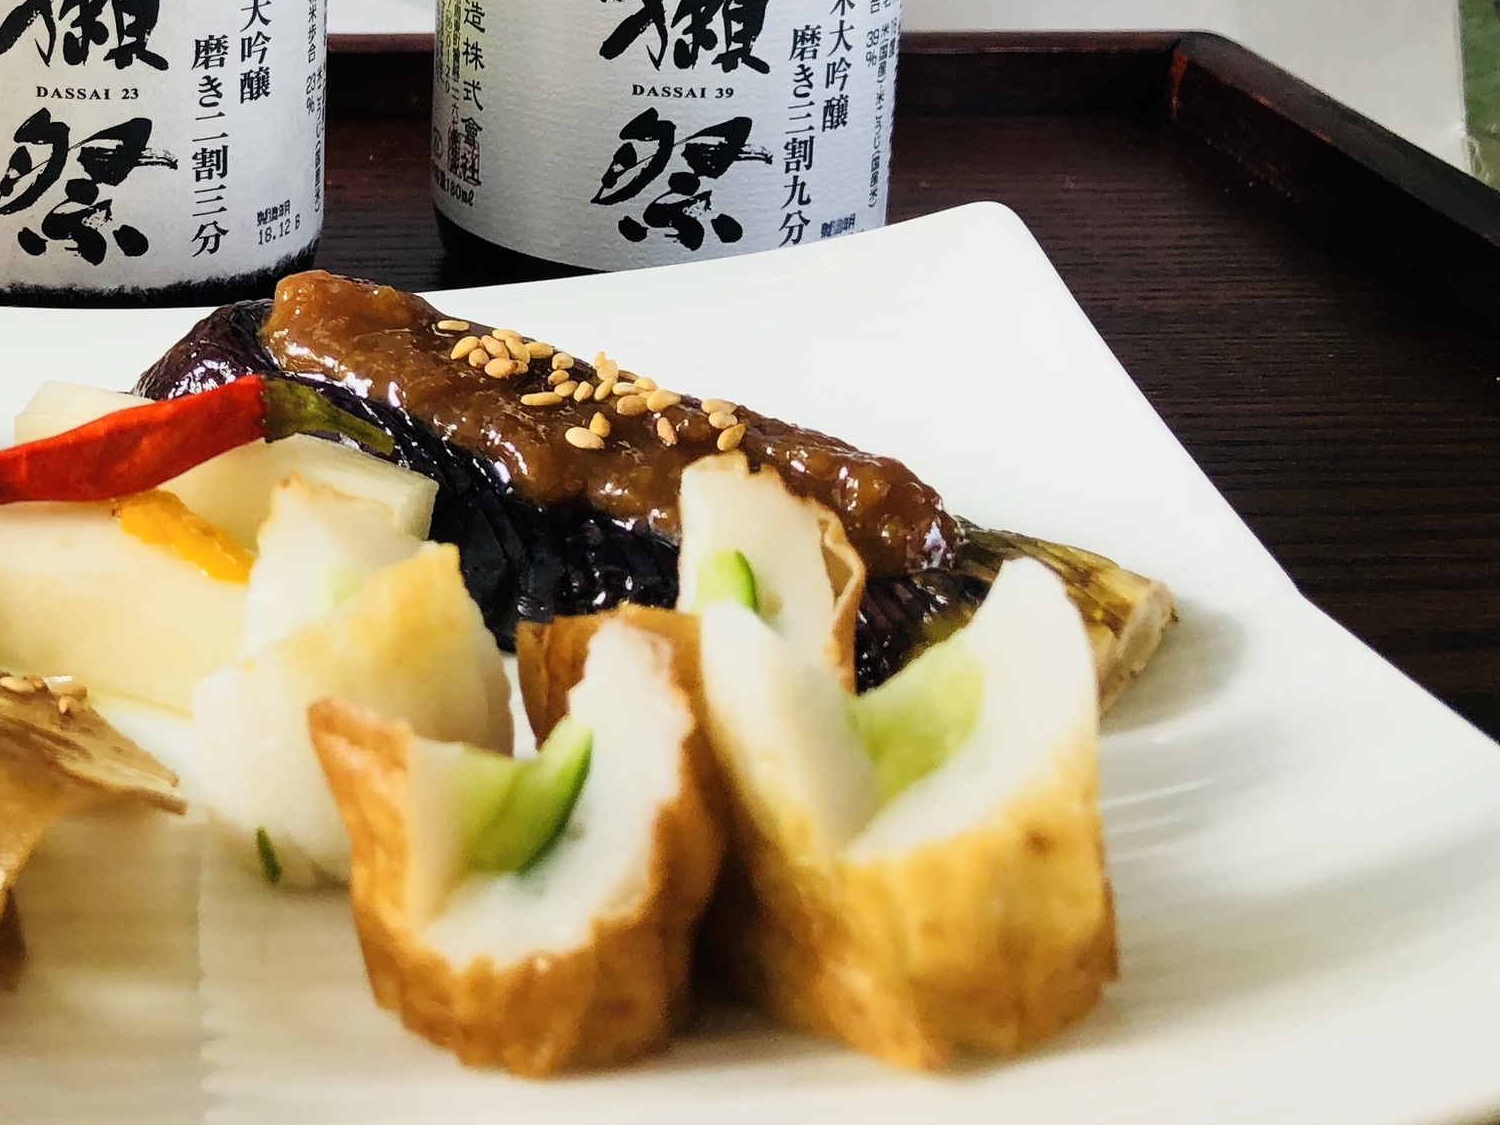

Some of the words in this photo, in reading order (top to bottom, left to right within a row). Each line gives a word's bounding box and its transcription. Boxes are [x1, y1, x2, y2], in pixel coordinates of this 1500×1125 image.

[36, 85, 111, 101] DASSAI
[121, 86, 140, 101] 23
[631, 84, 707, 100] DASSAI
[715, 86, 735, 100] 39
[191, 34, 230, 258] 磨き二割三分
[778, 25, 822, 248] 磨き三割九分
[258, 218, 291, 246] 18.12
